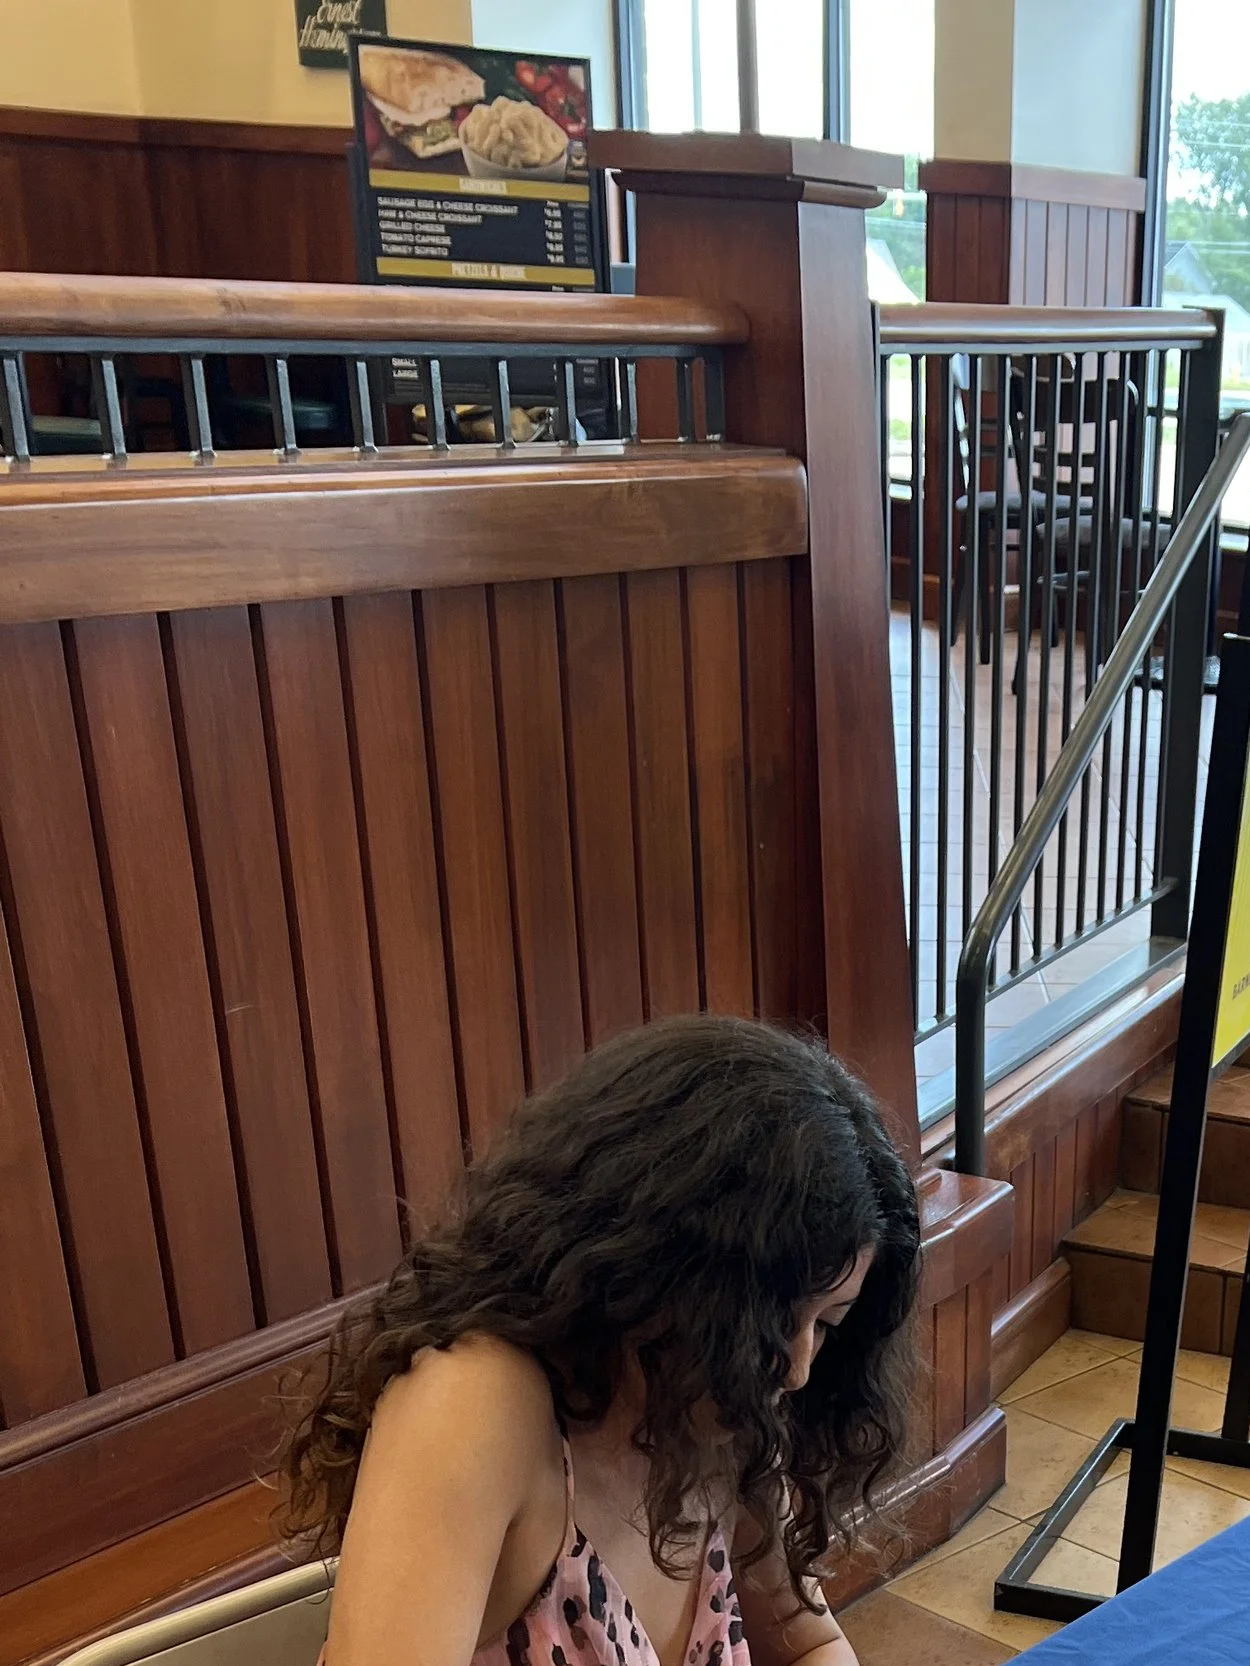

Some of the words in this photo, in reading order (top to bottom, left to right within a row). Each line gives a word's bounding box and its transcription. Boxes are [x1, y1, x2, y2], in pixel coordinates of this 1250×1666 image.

[443, 201, 474, 211] CHEESE
[405, 210, 437, 221] CHEESE
[414, 222, 445, 233] CHEESE
